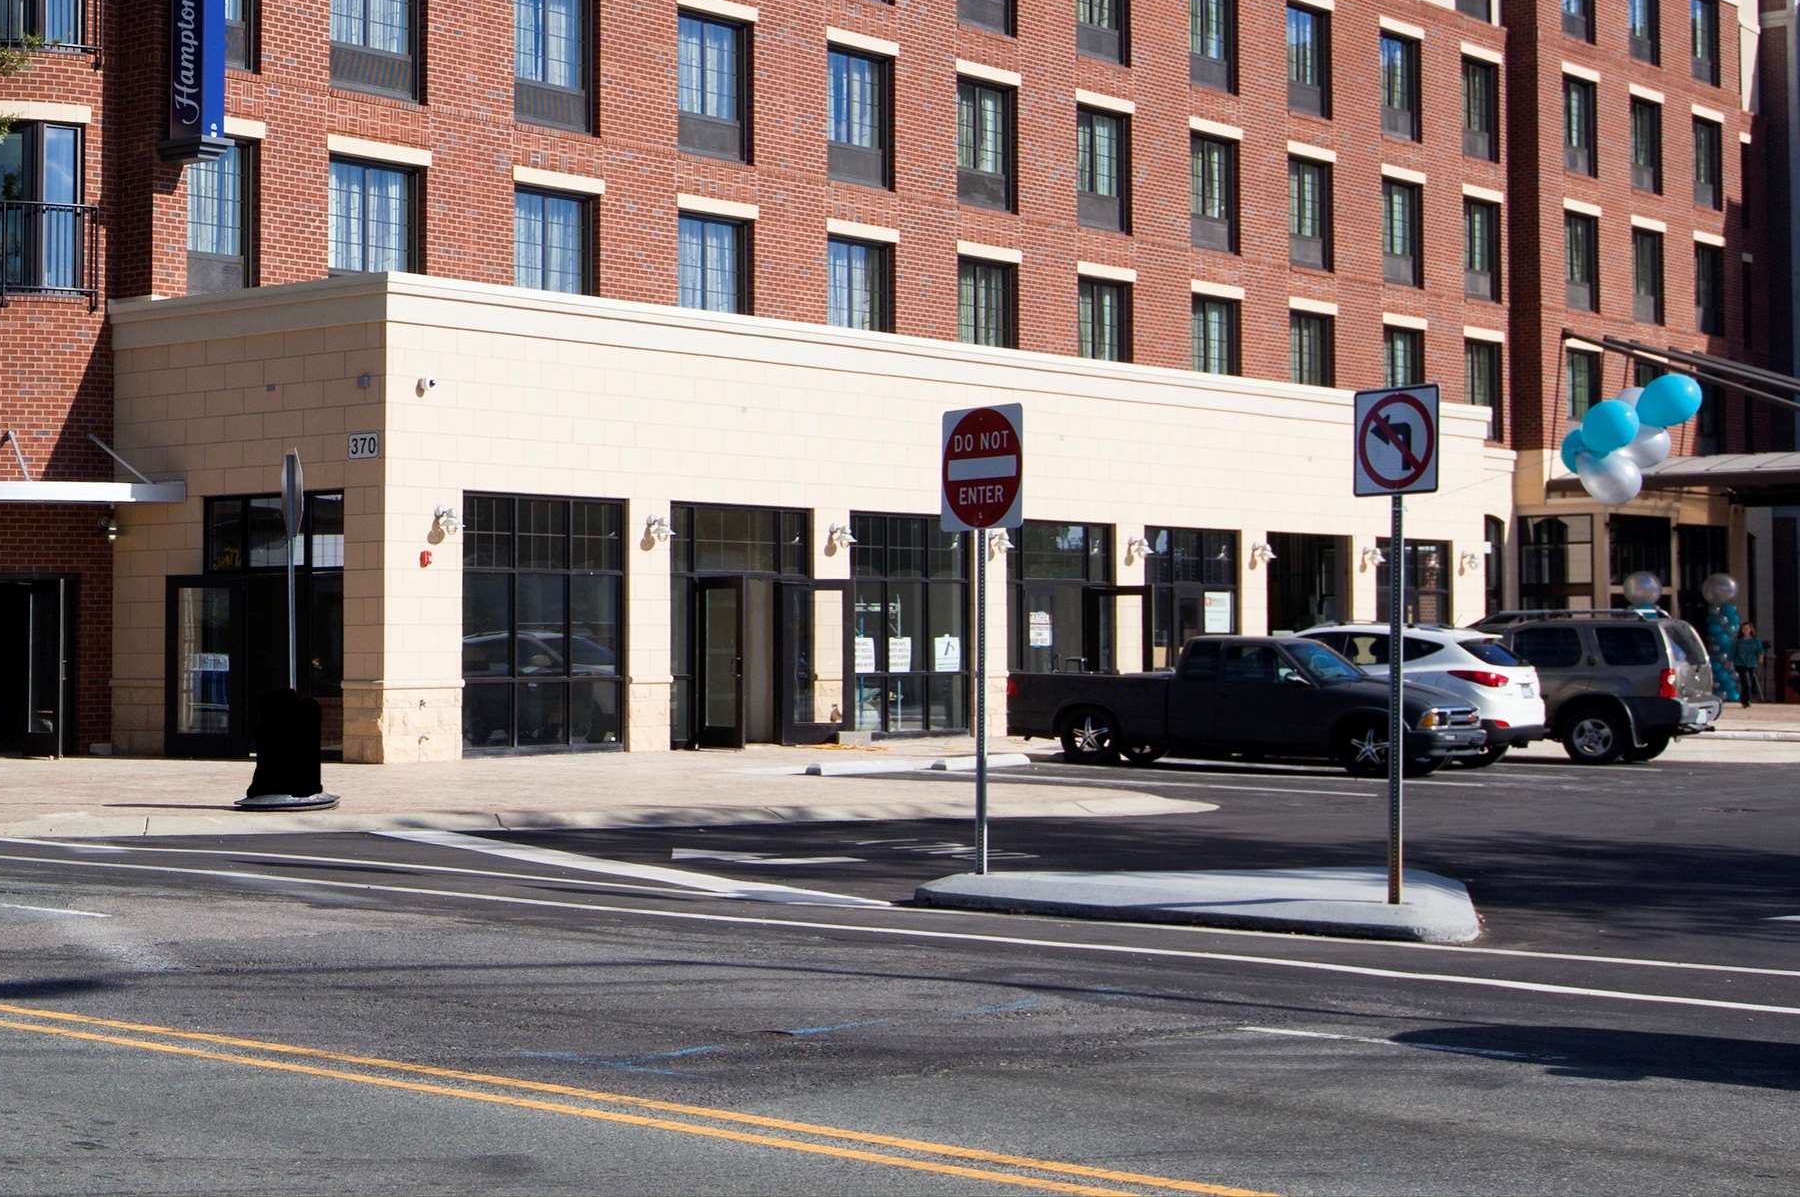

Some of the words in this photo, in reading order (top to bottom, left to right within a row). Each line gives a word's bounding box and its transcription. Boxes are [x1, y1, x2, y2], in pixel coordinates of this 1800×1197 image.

[351, 436, 376, 454] 370
[954, 434, 973, 452] DO
[980, 430, 1009, 450] NOT
[960, 484, 1004, 505] ENTER
